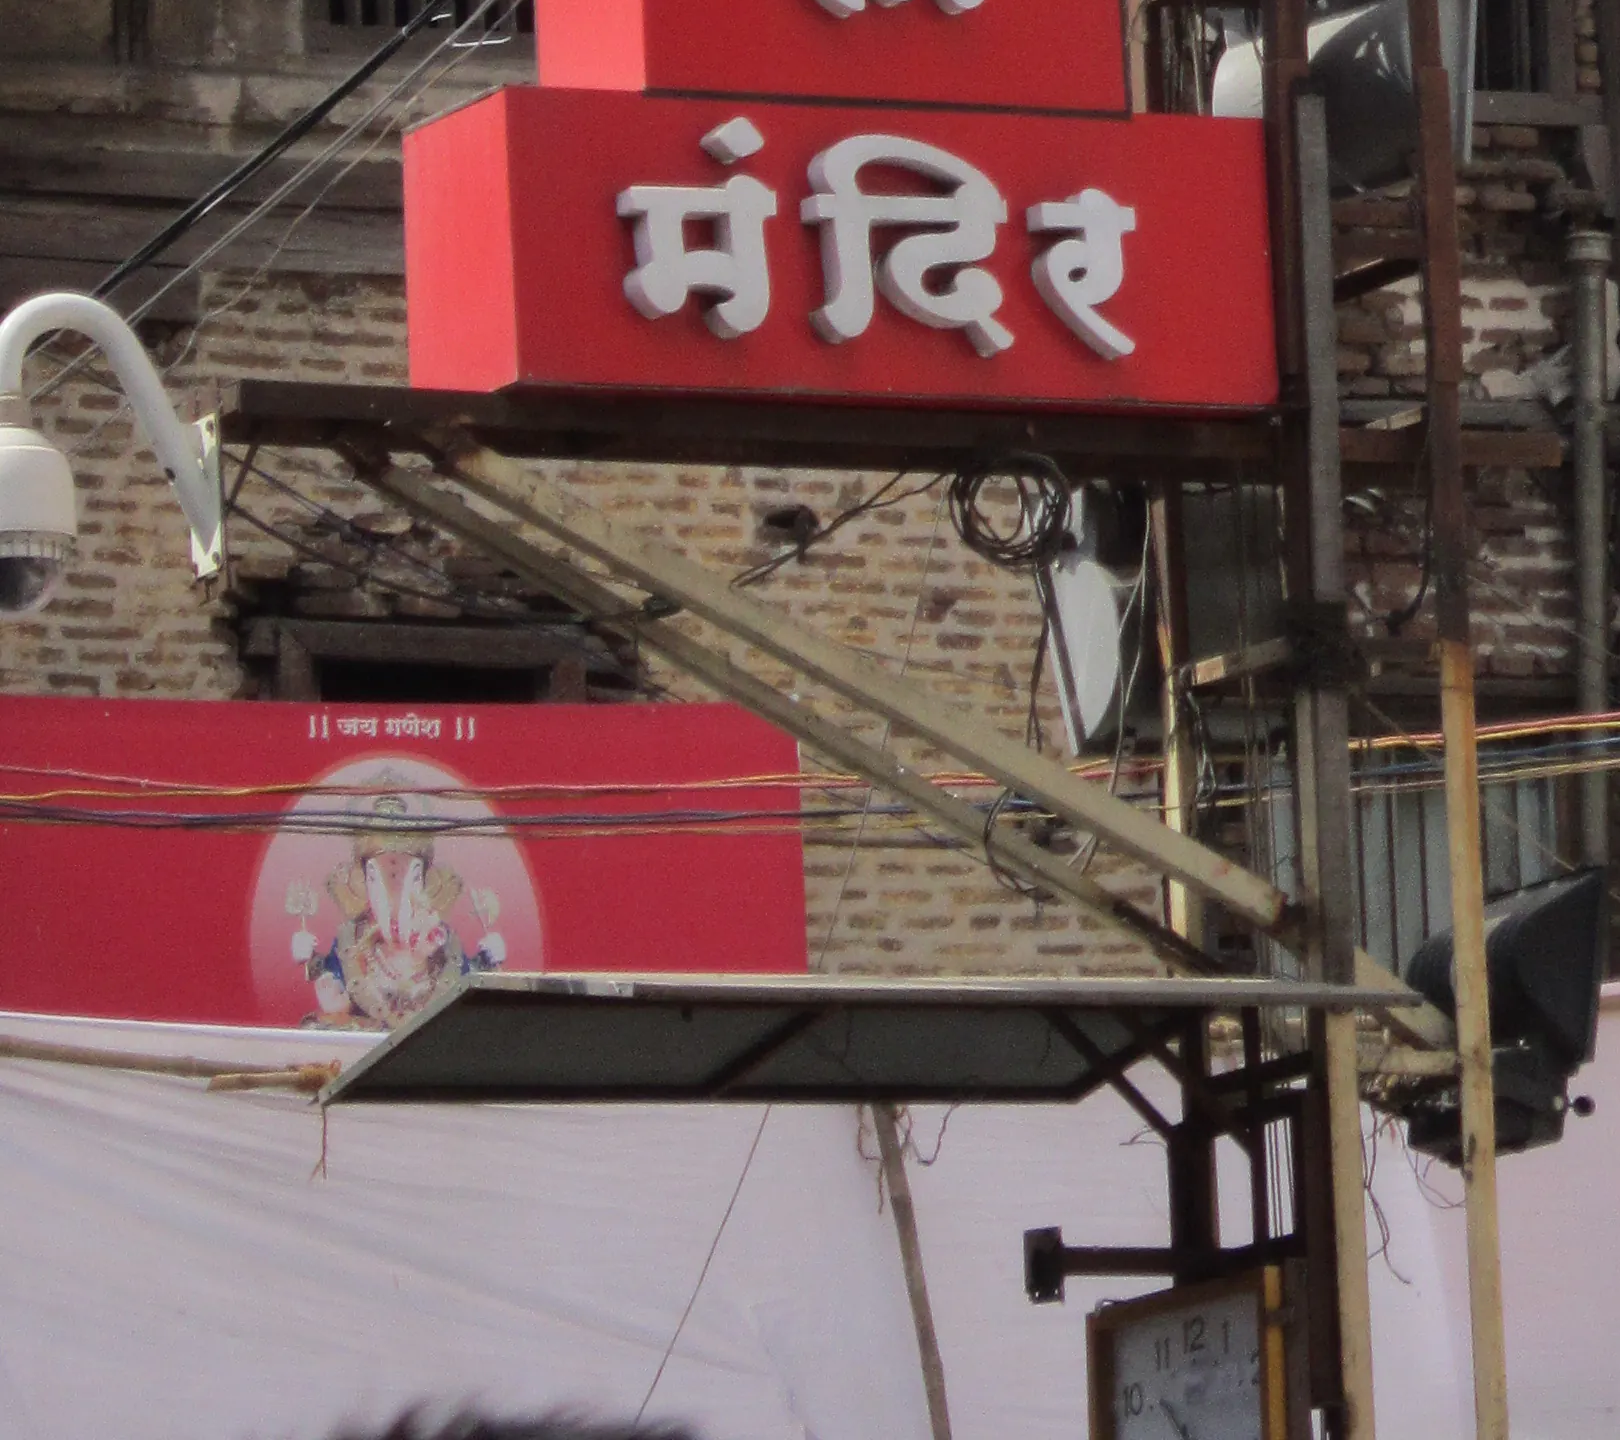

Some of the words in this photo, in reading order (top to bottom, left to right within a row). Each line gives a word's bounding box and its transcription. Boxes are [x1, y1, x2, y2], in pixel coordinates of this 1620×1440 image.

[616, 116, 1136, 360] मंदिर
[336, 718, 378, 738] जय
[384, 712, 442, 739] गणेश
[1154, 1337, 1170, 1370] 11
[1183, 1316, 1206, 1355] 12
[1123, 1382, 1144, 1419] 10
